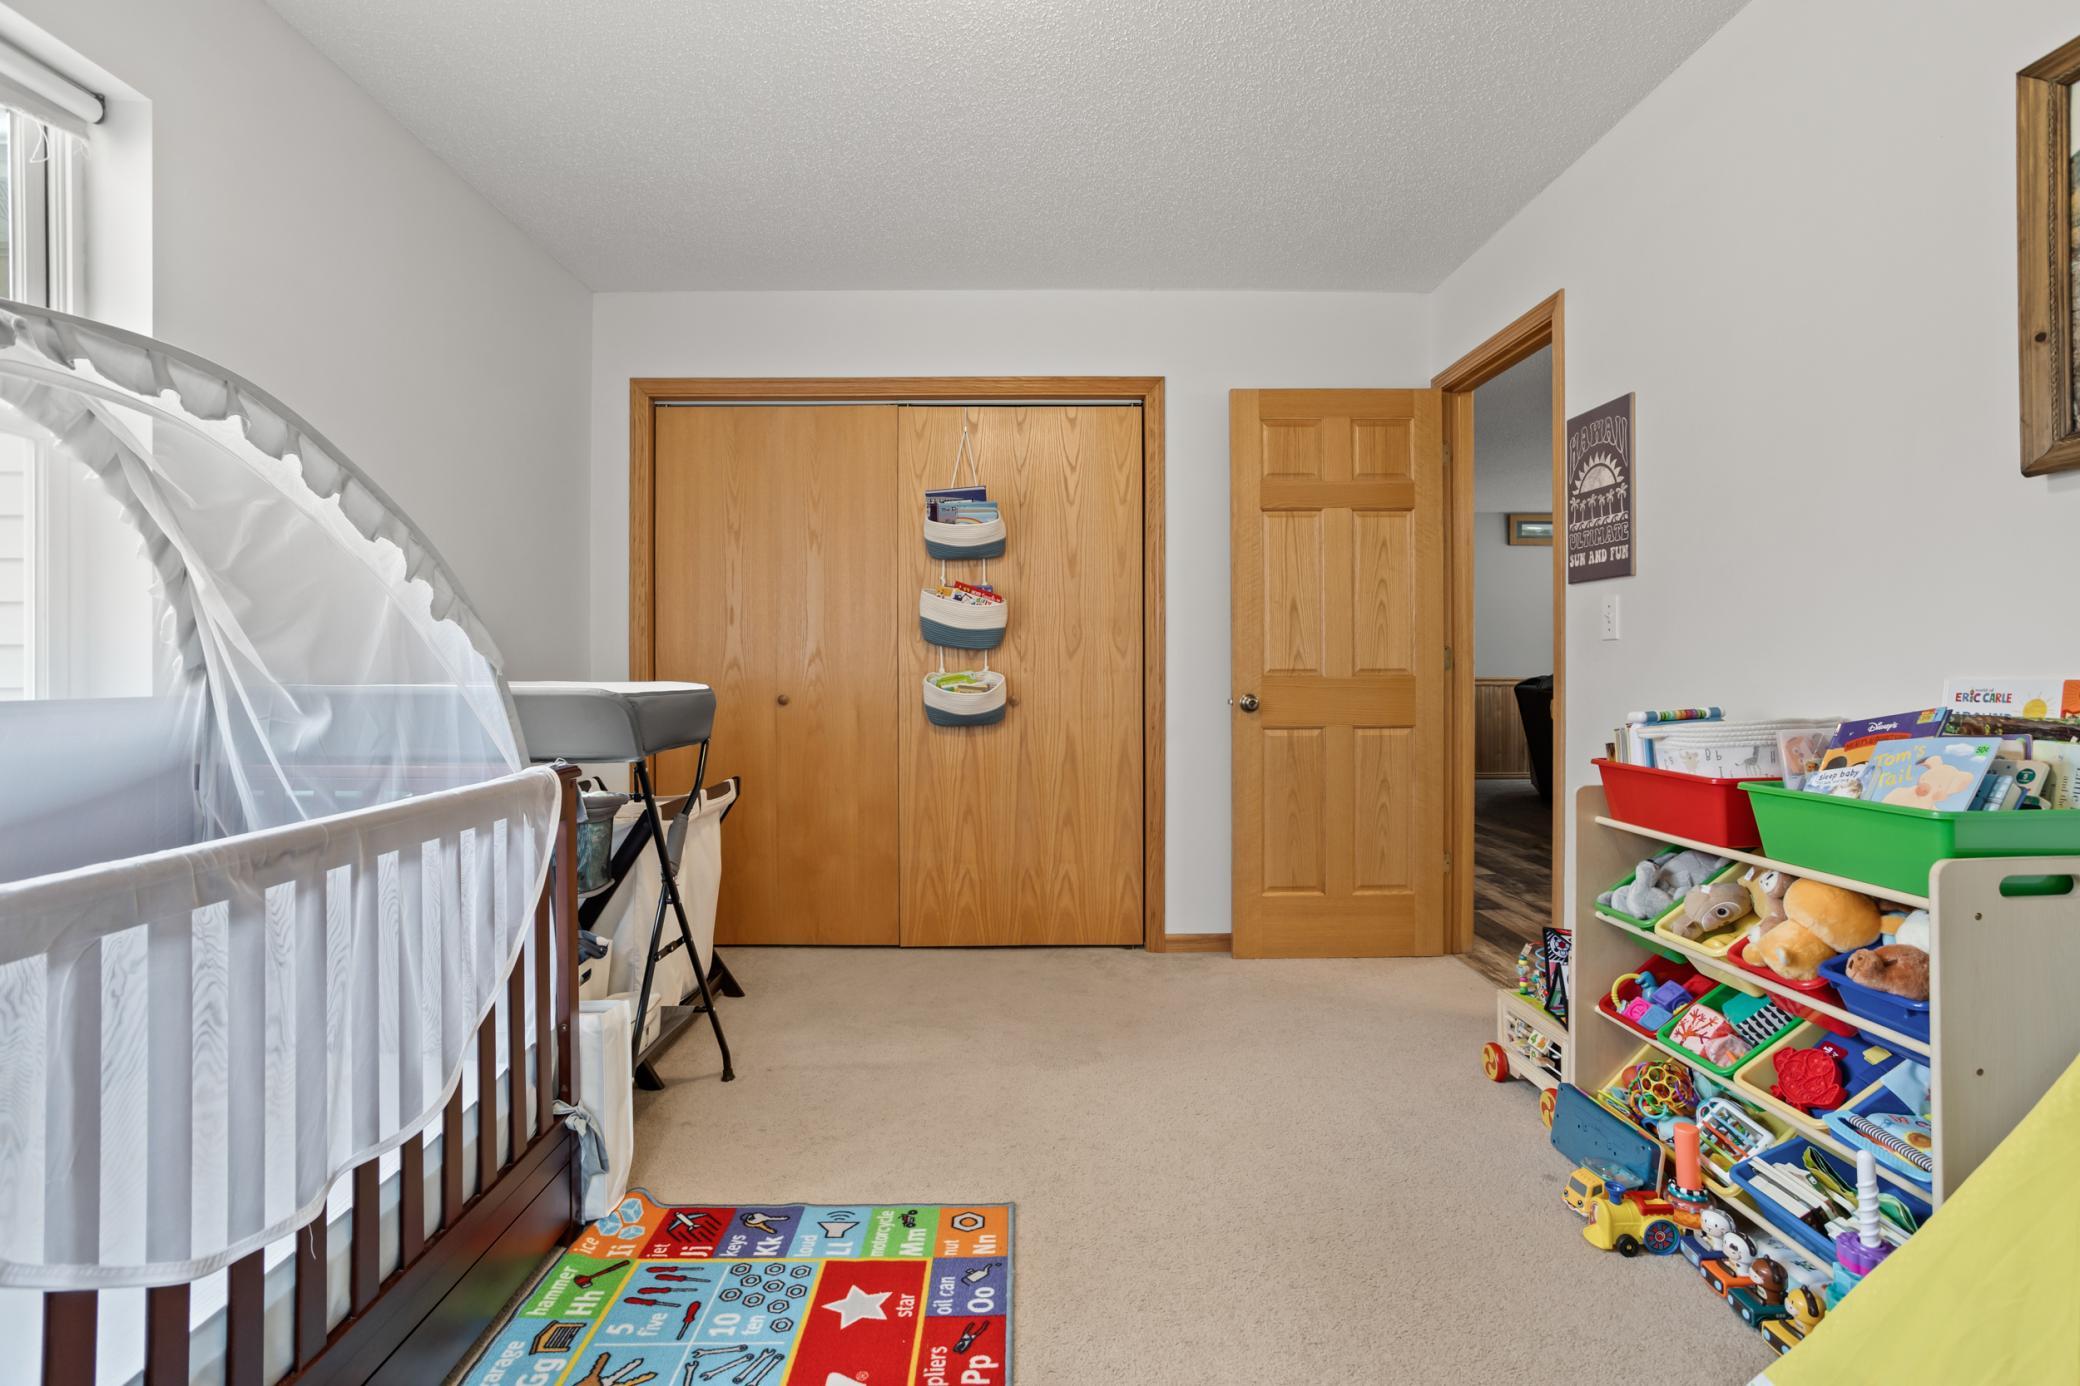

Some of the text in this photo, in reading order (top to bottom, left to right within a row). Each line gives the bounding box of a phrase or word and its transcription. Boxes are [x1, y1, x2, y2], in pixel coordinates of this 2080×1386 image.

[1569, 416, 1628, 485] HAWAII
[1569, 521, 1629, 550] ULTIMATE
[1569, 544, 1629, 568] SUN AND FUN
[1983, 693, 2012, 703] CARLE
[574, 1236, 599, 1255] ice
[720, 1234, 747, 1256] keys
[753, 1235, 784, 1256] Kk
[794, 1234, 817, 1257] loud
[870, 1210, 894, 1257] motorcycle
[899, 1228, 926, 1256] Mm
[972, 1234, 996, 1255] Nn
[647, 1243, 671, 1257] jet
[943, 1239, 960, 1257] nut
[526, 1265, 580, 1316] hammer
[564, 1290, 605, 1316] Hh
[932, 1276, 956, 1315] oil can
[895, 1293, 915, 1318] star
[606, 1323, 634, 1335] 5
[636, 1312, 668, 1337] five
[708, 1312, 741, 1337] 10
[741, 1315, 766, 1336] ten
[923, 1346, 948, 1386] pliers
[961, 1354, 999, 1385] Pp
